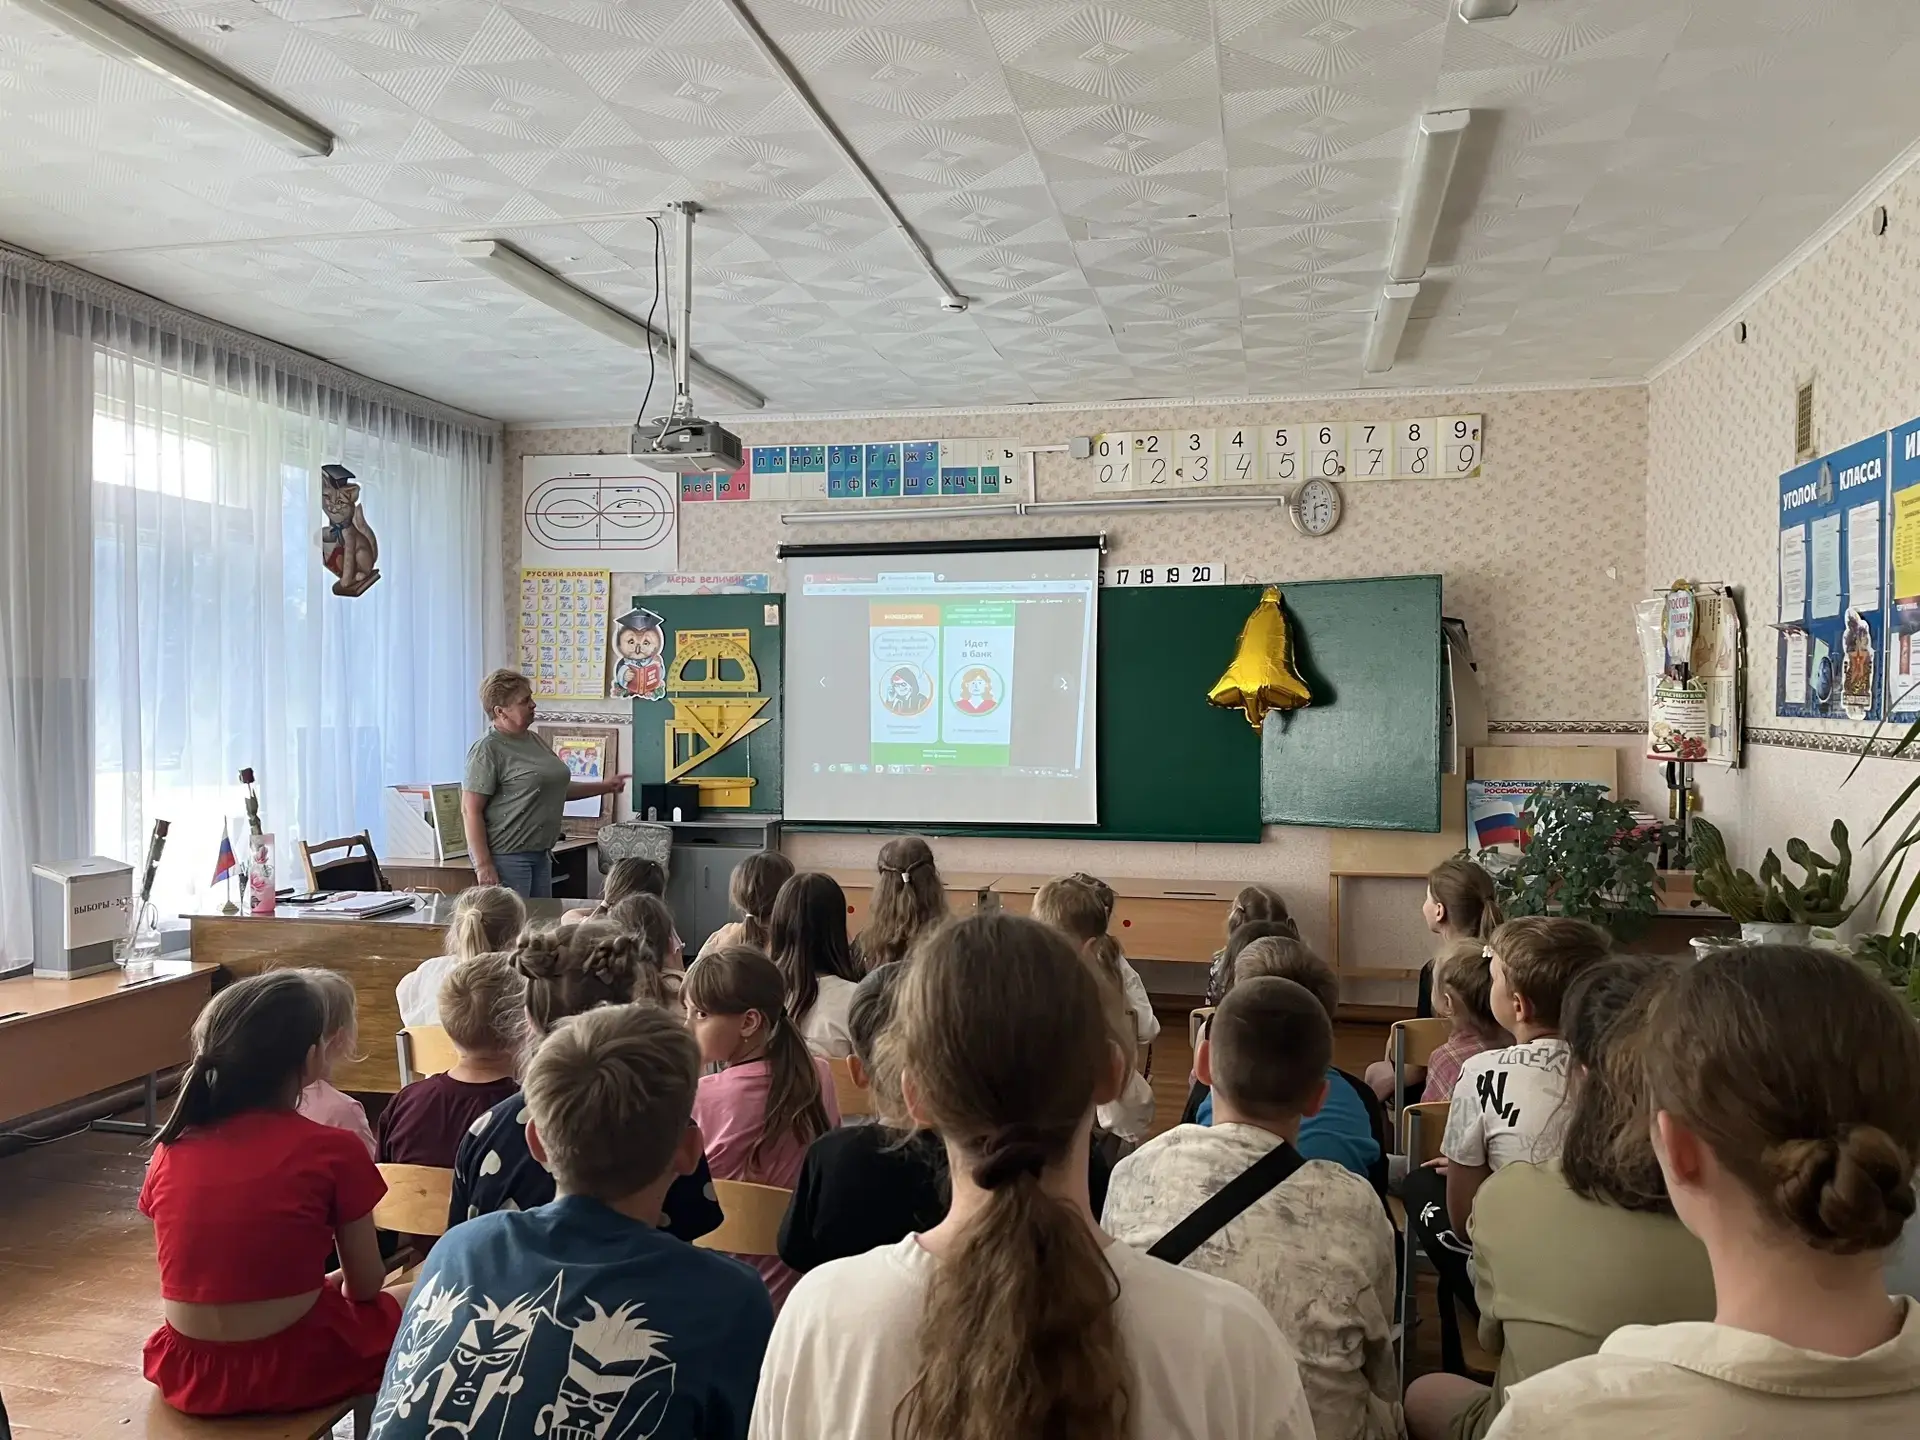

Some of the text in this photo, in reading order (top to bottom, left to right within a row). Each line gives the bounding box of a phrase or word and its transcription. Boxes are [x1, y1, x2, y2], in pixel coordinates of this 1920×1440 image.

[1100, 421, 1466, 456] 0 1 2 3 4 5 6 7 8 9
[757, 457, 783, 466] л м
[792, 454, 824, 466] н р й
[832, 452, 858, 464] б в
[887, 454, 896, 464] д
[906, 452, 933, 460] ж з
[1100, 445, 1474, 484] 0 1 2 3 4 5 6 7 8 9
[1840, 458, 1881, 490] КЛАССА
[705, 481, 712, 492] ё
[833, 478, 860, 490] п ф
[871, 479, 896, 487] к т
[926, 478, 934, 486] с
[943, 477, 951, 485] х
[956, 476, 964, 487] ц
[984, 476, 996, 486] щ
[720, 483, 730, 491] ю
[1783, 482, 1817, 511] УГОЛОК
[1117, 570, 1129, 584] 17
[1140, 569, 1153, 584] 18
[1167, 568, 1179, 583] 19
[1192, 567, 1210, 582] 20
[964, 639, 988, 649] Идет
[74, 901, 110, 914] ВЫБОРЫ
